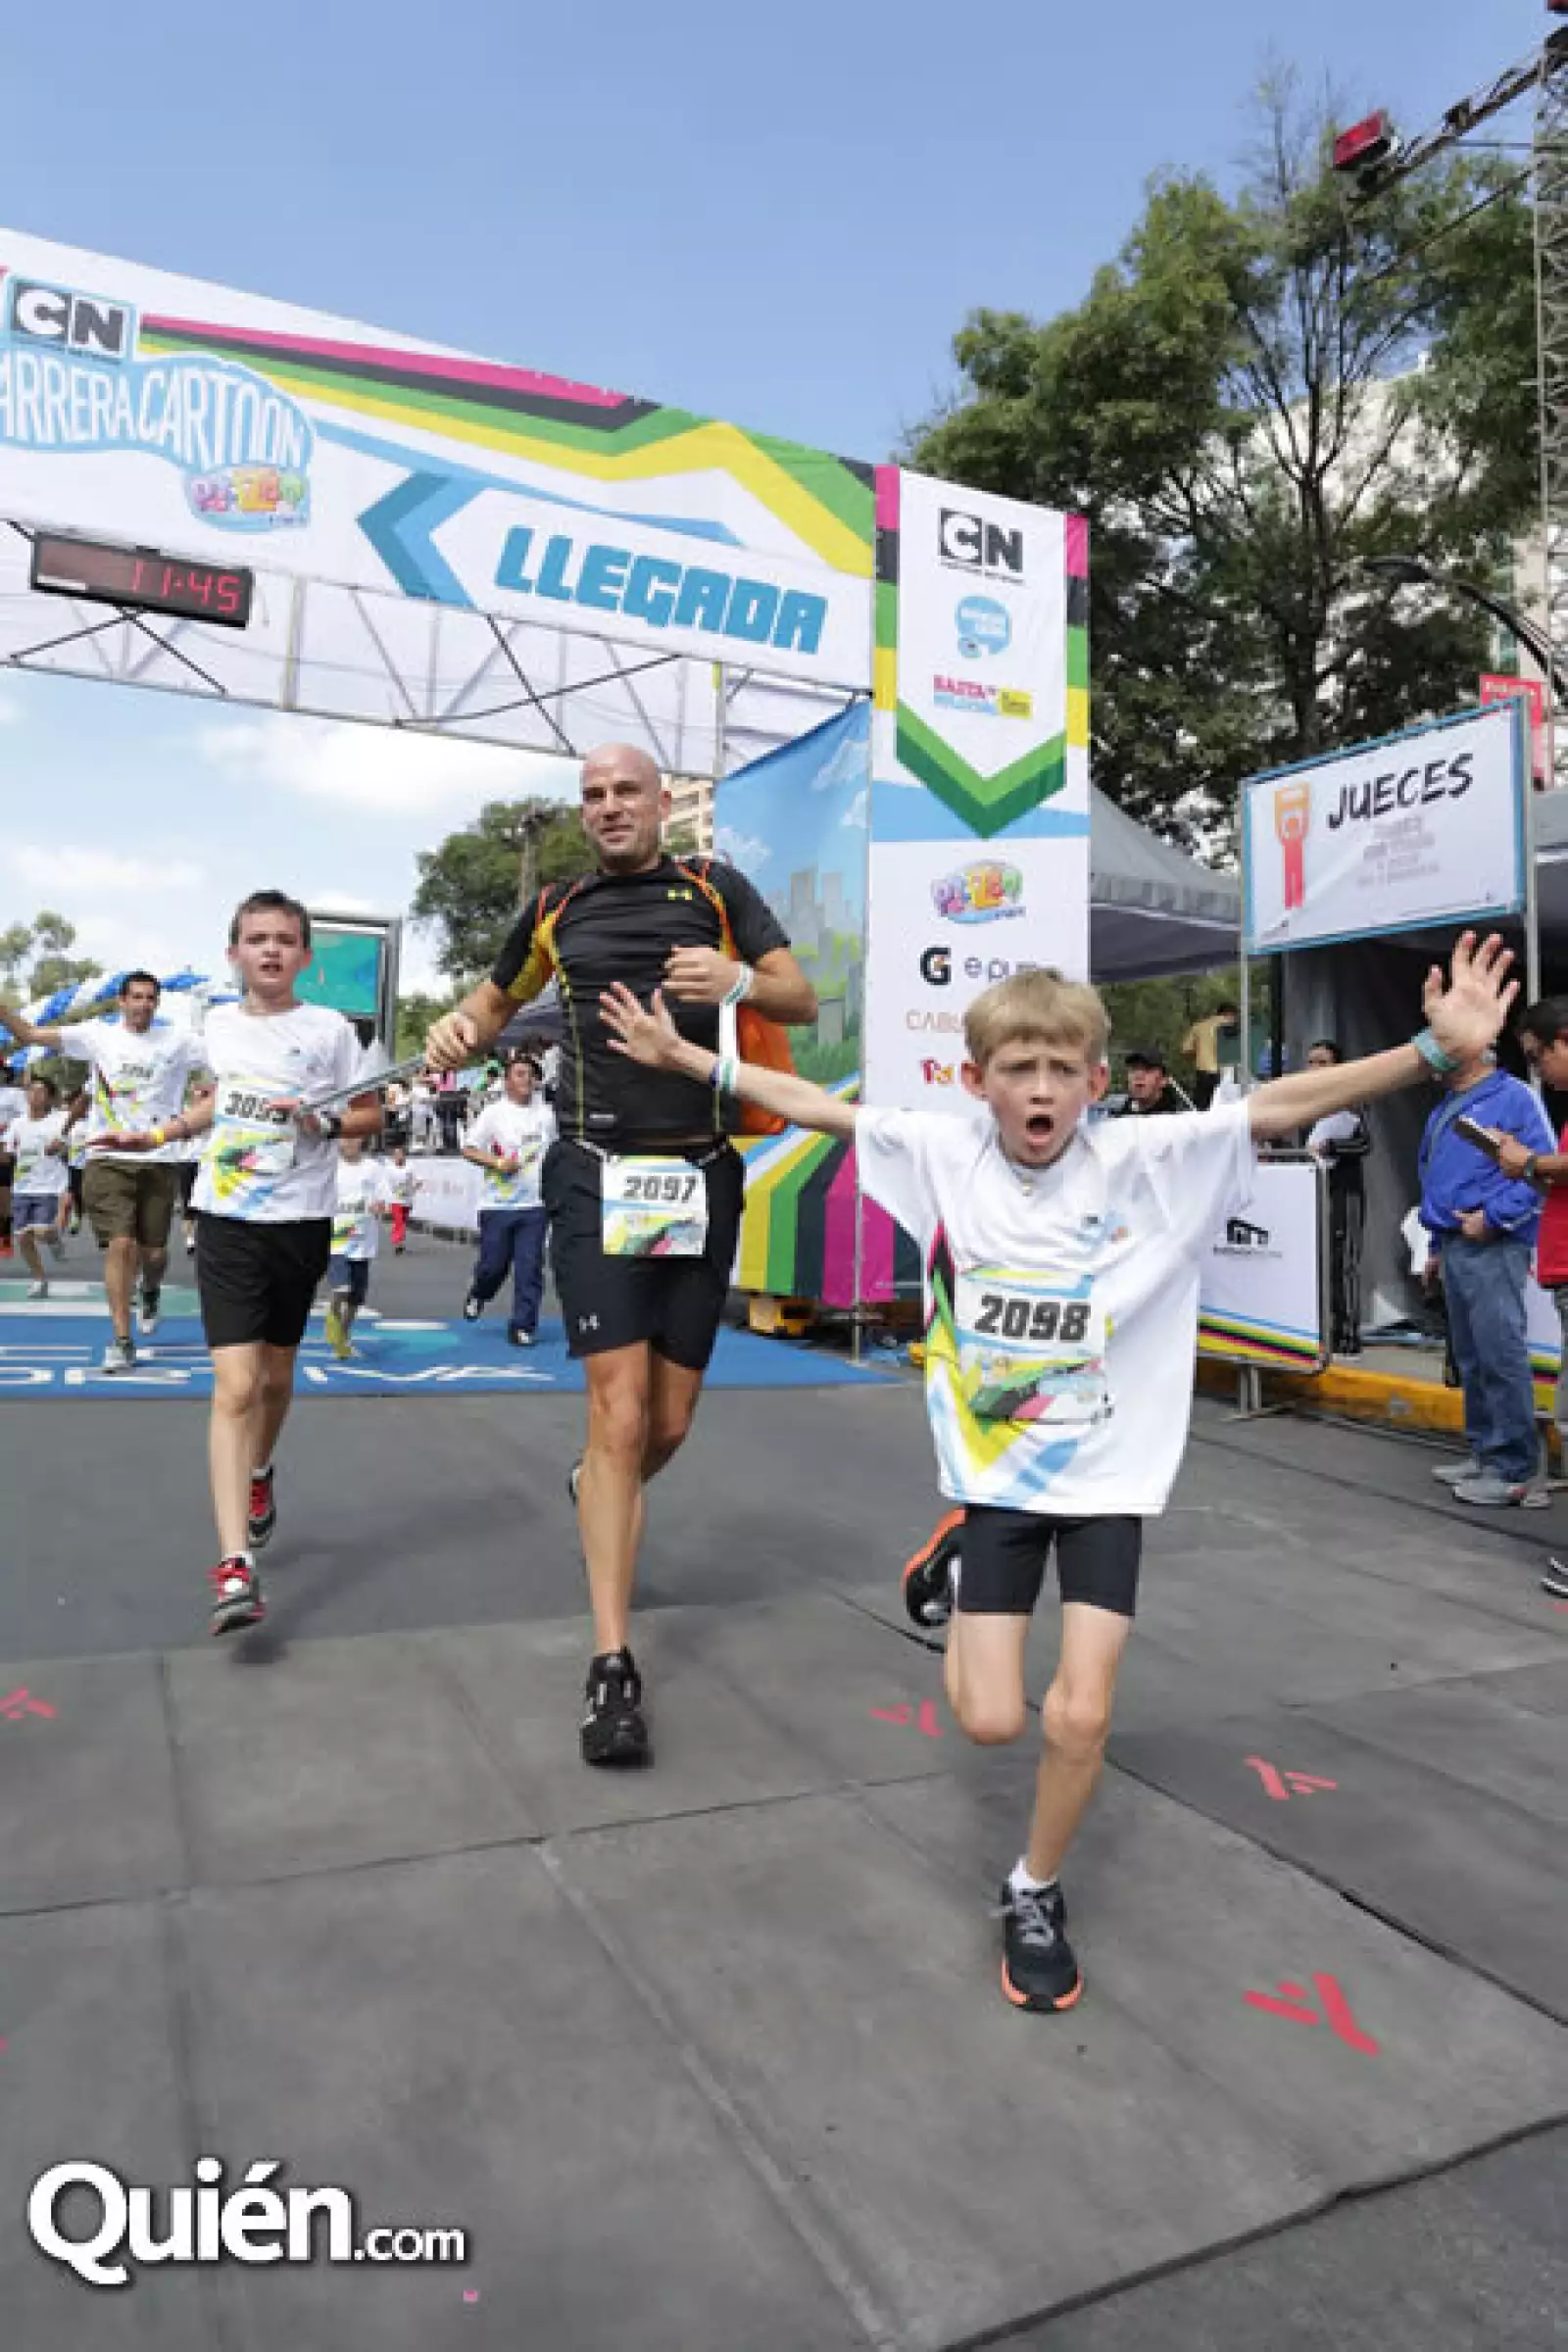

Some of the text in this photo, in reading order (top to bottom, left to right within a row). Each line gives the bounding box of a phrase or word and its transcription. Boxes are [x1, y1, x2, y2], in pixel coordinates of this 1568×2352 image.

[11, 282, 124, 353] CN
[138, 366, 305, 471] CARTOON
[938, 507, 1024, 572] CN
[494, 526, 829, 655] LLEGADA
[1326, 753, 1474, 830] JUECES
[622, 1175, 697, 1204] 2097
[974, 1292, 1092, 1342] 2098
